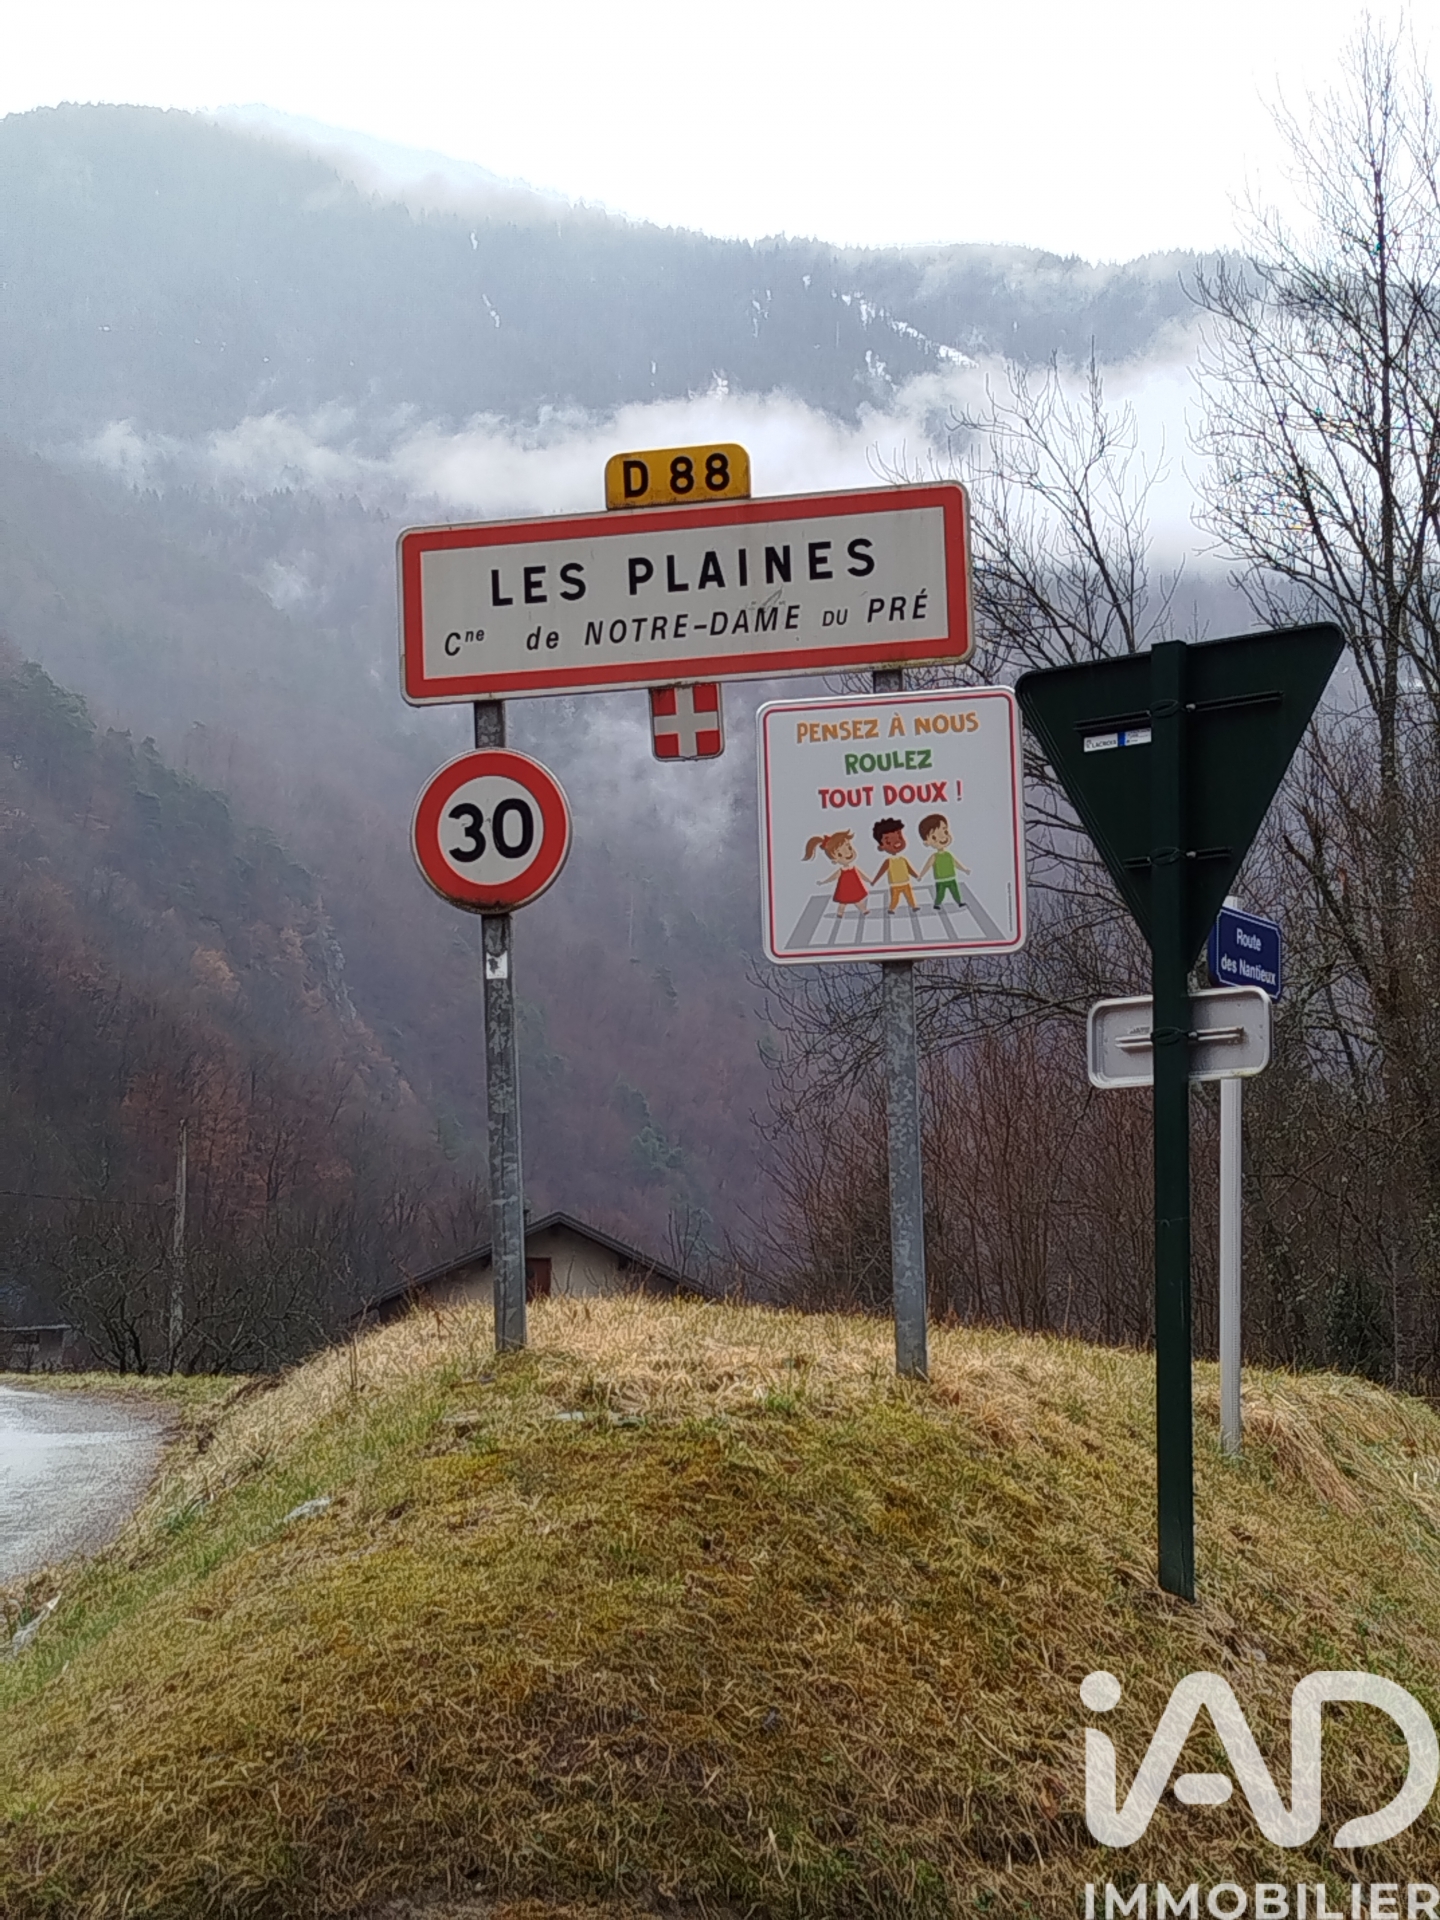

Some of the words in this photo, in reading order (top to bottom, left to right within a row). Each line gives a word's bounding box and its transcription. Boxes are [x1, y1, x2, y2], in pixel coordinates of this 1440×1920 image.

[623, 459, 649, 498] D
[670, 453, 730, 494] 88
[491, 563, 586, 606] LES
[628, 538, 875, 595] PLAINES
[526, 626, 559, 650] de
[585, 605, 800, 645] NOTRE-DAME
[822, 609, 848, 627] DU
[867, 588, 928, 624] PRÉ
[797, 718, 879, 743] PENSEZ
[888, 712, 905, 737] À
[914, 712, 979, 736] NOUS
[845, 749, 932, 775] ROULEZ
[818, 785, 874, 809] TOUT
[883, 781, 947, 806] DOUX
[956, 780, 962, 801] !
[449, 798, 534, 863] 30
[1236, 928, 1261, 951] Route
[1221, 953, 1237, 974] des
